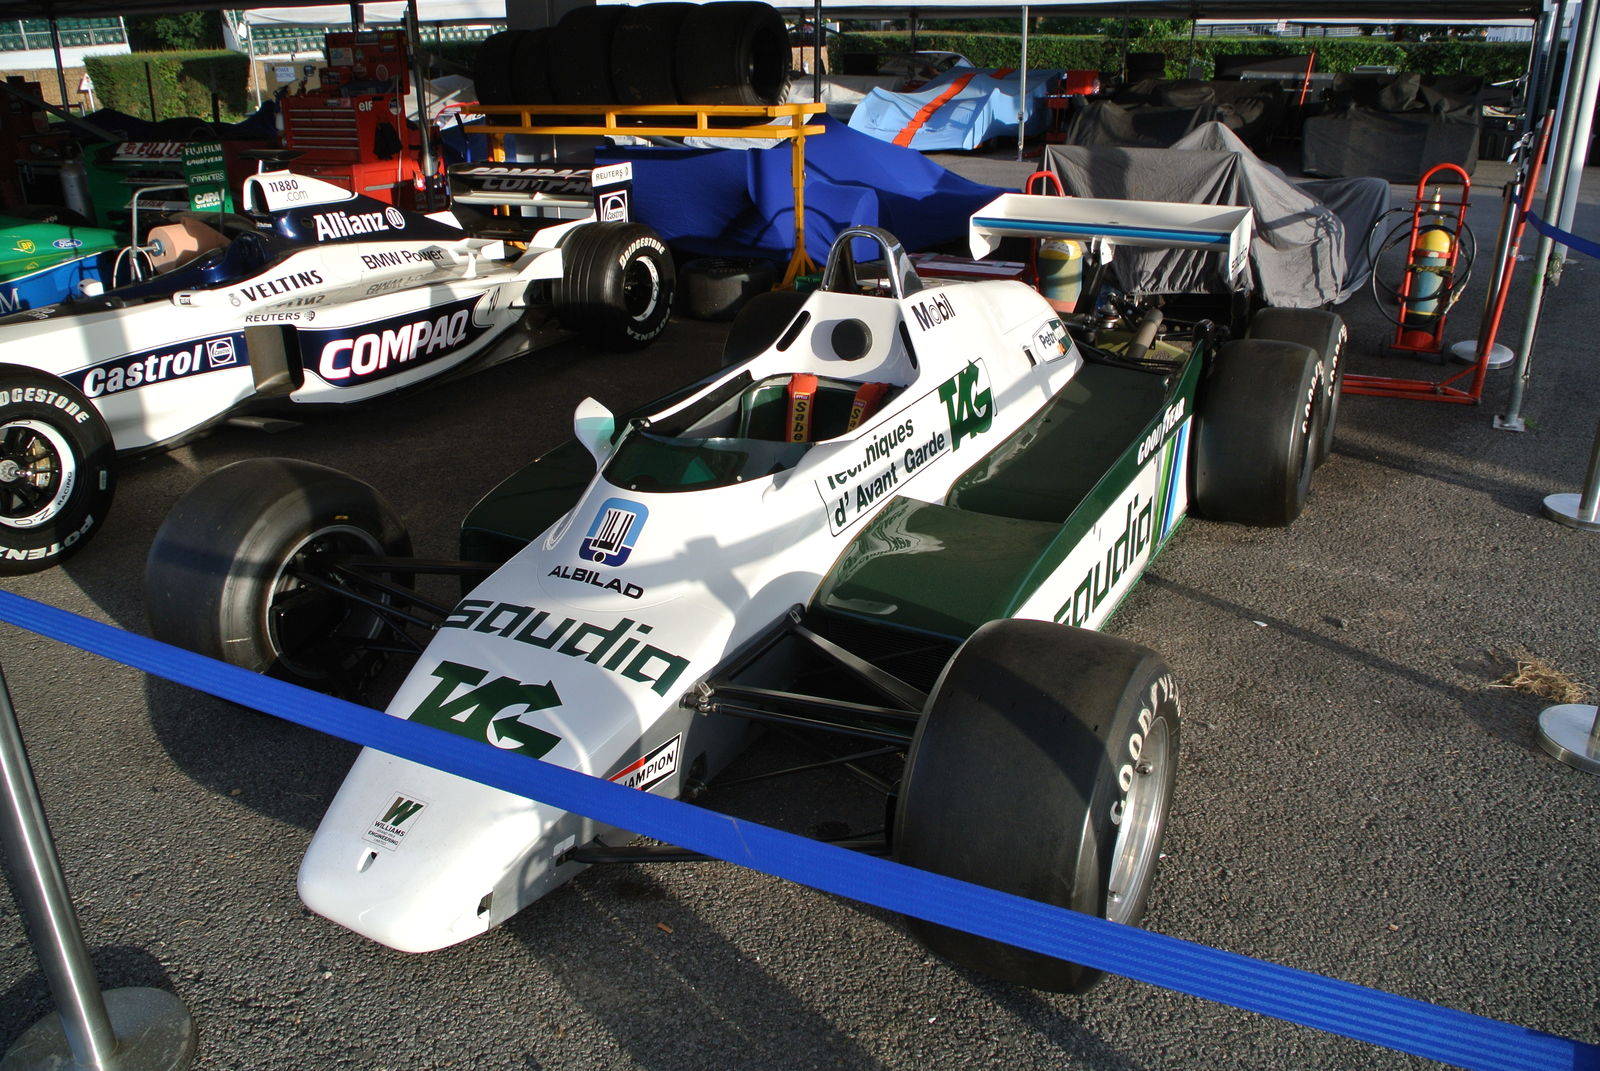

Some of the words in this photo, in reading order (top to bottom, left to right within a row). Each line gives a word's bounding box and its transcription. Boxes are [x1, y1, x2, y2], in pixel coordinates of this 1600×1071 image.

[359, 101, 373, 111] elf
[269, 179, 299, 193] 11880
[595, 169, 623, 180] REUTERS
[286, 189, 309, 202] .com
[313, 210, 390, 242] Allianz
[21, 242, 33, 250] BP
[361, 251, 402, 270] BMW
[400, 249, 445, 263] Power
[619, 237, 666, 270] BRIDGESTONE
[240, 269, 323, 302] VELTINS
[245, 312, 301, 323] REUTERS
[911, 293, 956, 332] Mobil
[318, 308, 469, 381] COMPAQ
[83, 344, 203, 399] Castrol
[848, 407, 861, 432] Sa
[938, 358, 993, 453] TAG
[56, 471, 73, 506] RACING
[856, 461, 899, 514] Avant
[903, 431, 945, 473] Garde
[547, 565, 644, 599] ALBILAD
[404, 660, 563, 760] TAG
[624, 750, 674, 788] AMPION
[374, 820, 406, 838] WILLIAMS
